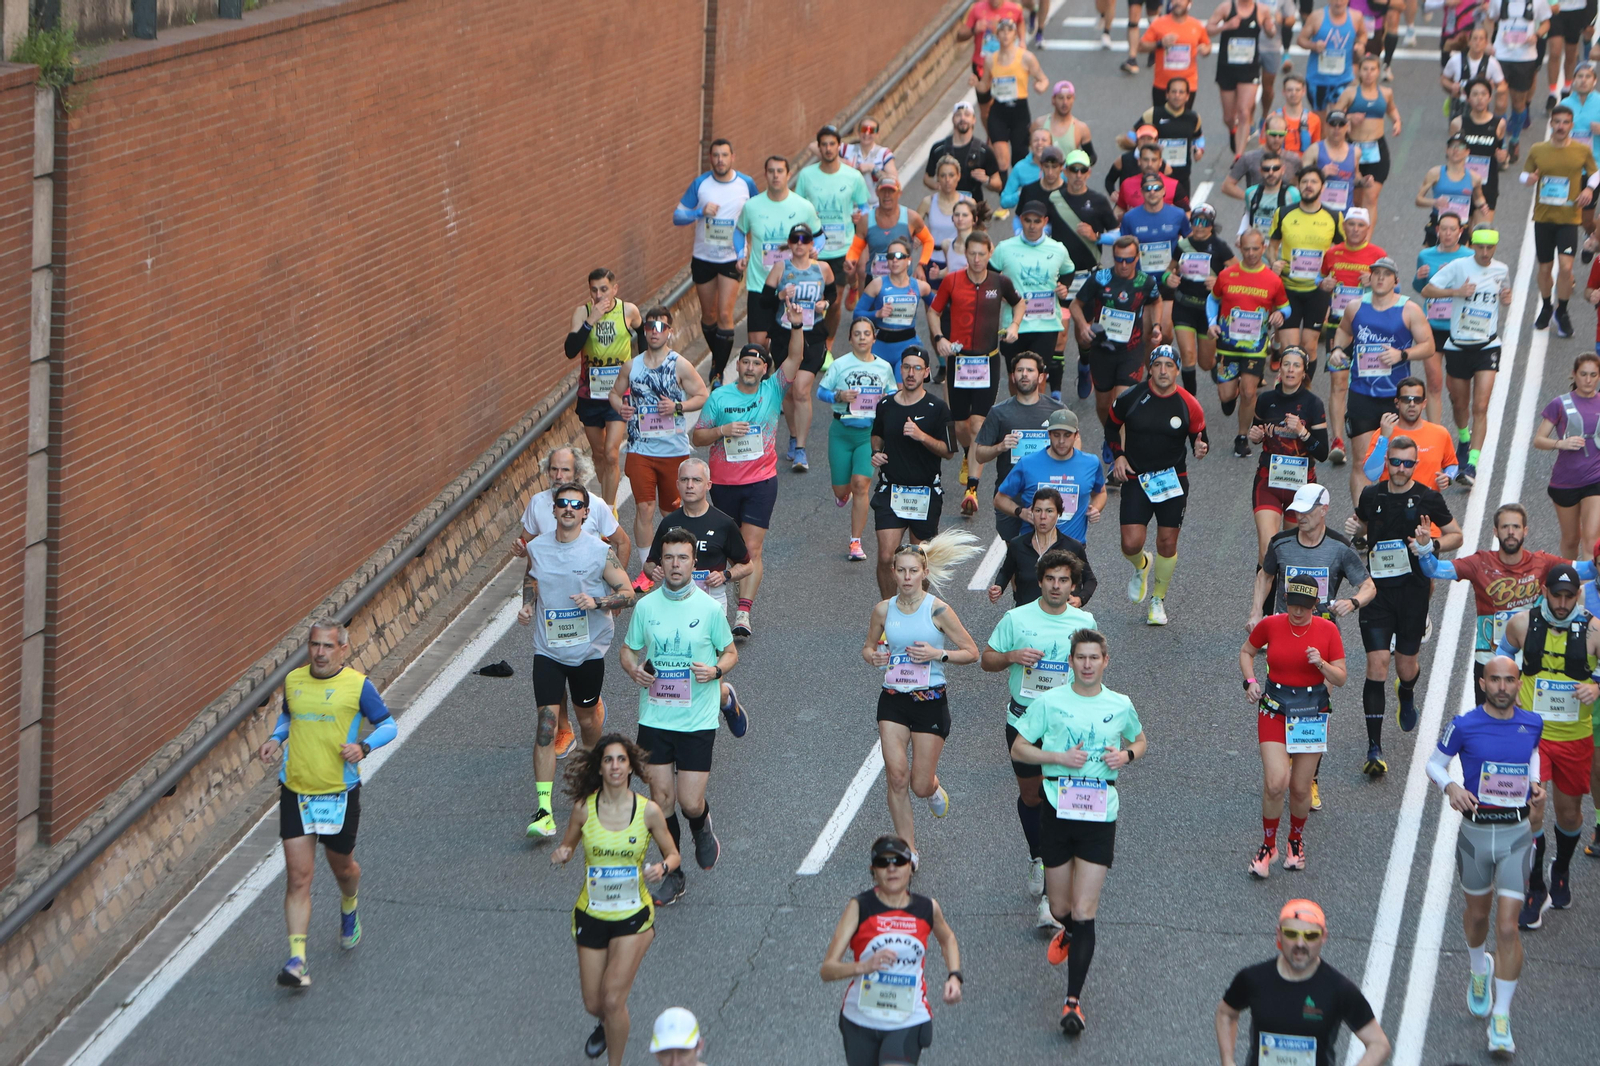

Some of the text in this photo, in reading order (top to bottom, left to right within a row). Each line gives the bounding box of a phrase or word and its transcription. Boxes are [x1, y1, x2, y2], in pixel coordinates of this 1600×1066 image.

[596, 320, 616, 336] ROCK
[598, 334, 614, 346] RUN
[1292, 584, 1314, 595] FIERCE
[1485, 576, 1542, 606] Beer
[558, 610, 582, 618] ZURICH
[654, 660, 691, 668] SEVILLA'24
[1040, 661, 1065, 670] ZURICH
[1500, 766, 1525, 775] ZURICH
[1076, 780, 1102, 789] ZURICH
[1076, 793, 1091, 801] 7542
[1072, 802, 1093, 810] VICENTE
[604, 868, 632, 877] ZURICH
[882, 974, 911, 986] ZURICH
